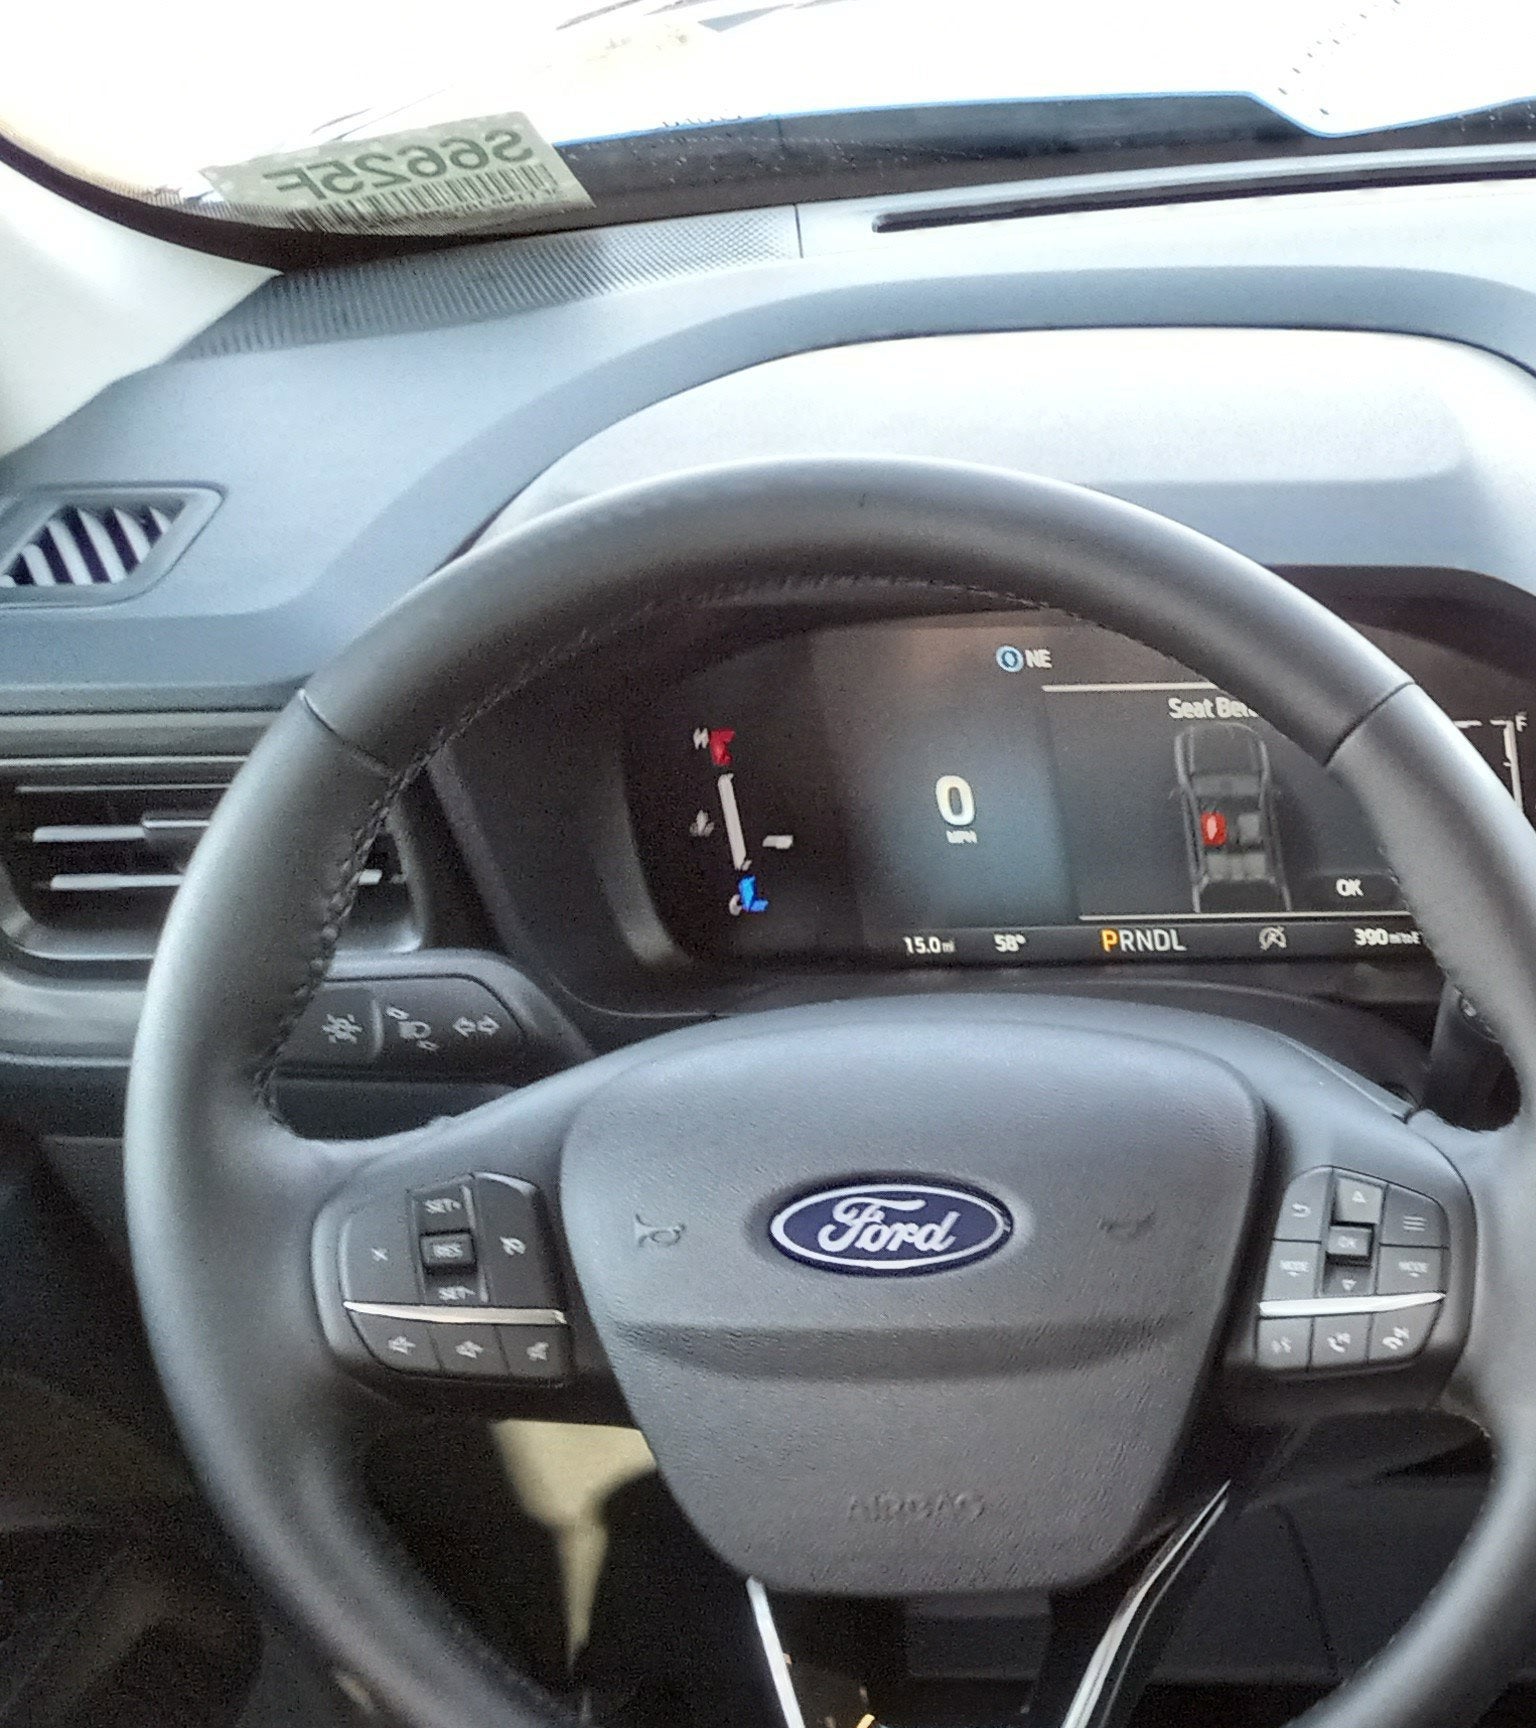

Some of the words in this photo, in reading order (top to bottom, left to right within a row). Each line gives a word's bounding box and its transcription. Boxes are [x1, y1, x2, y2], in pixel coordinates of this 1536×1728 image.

[1025, 650, 1052, 669] NE
[1168, 697, 1215, 719] Seat
[935, 775, 976, 826] 0
[1336, 879, 1364, 896] OK
[817, 1196, 961, 1252] Ford
